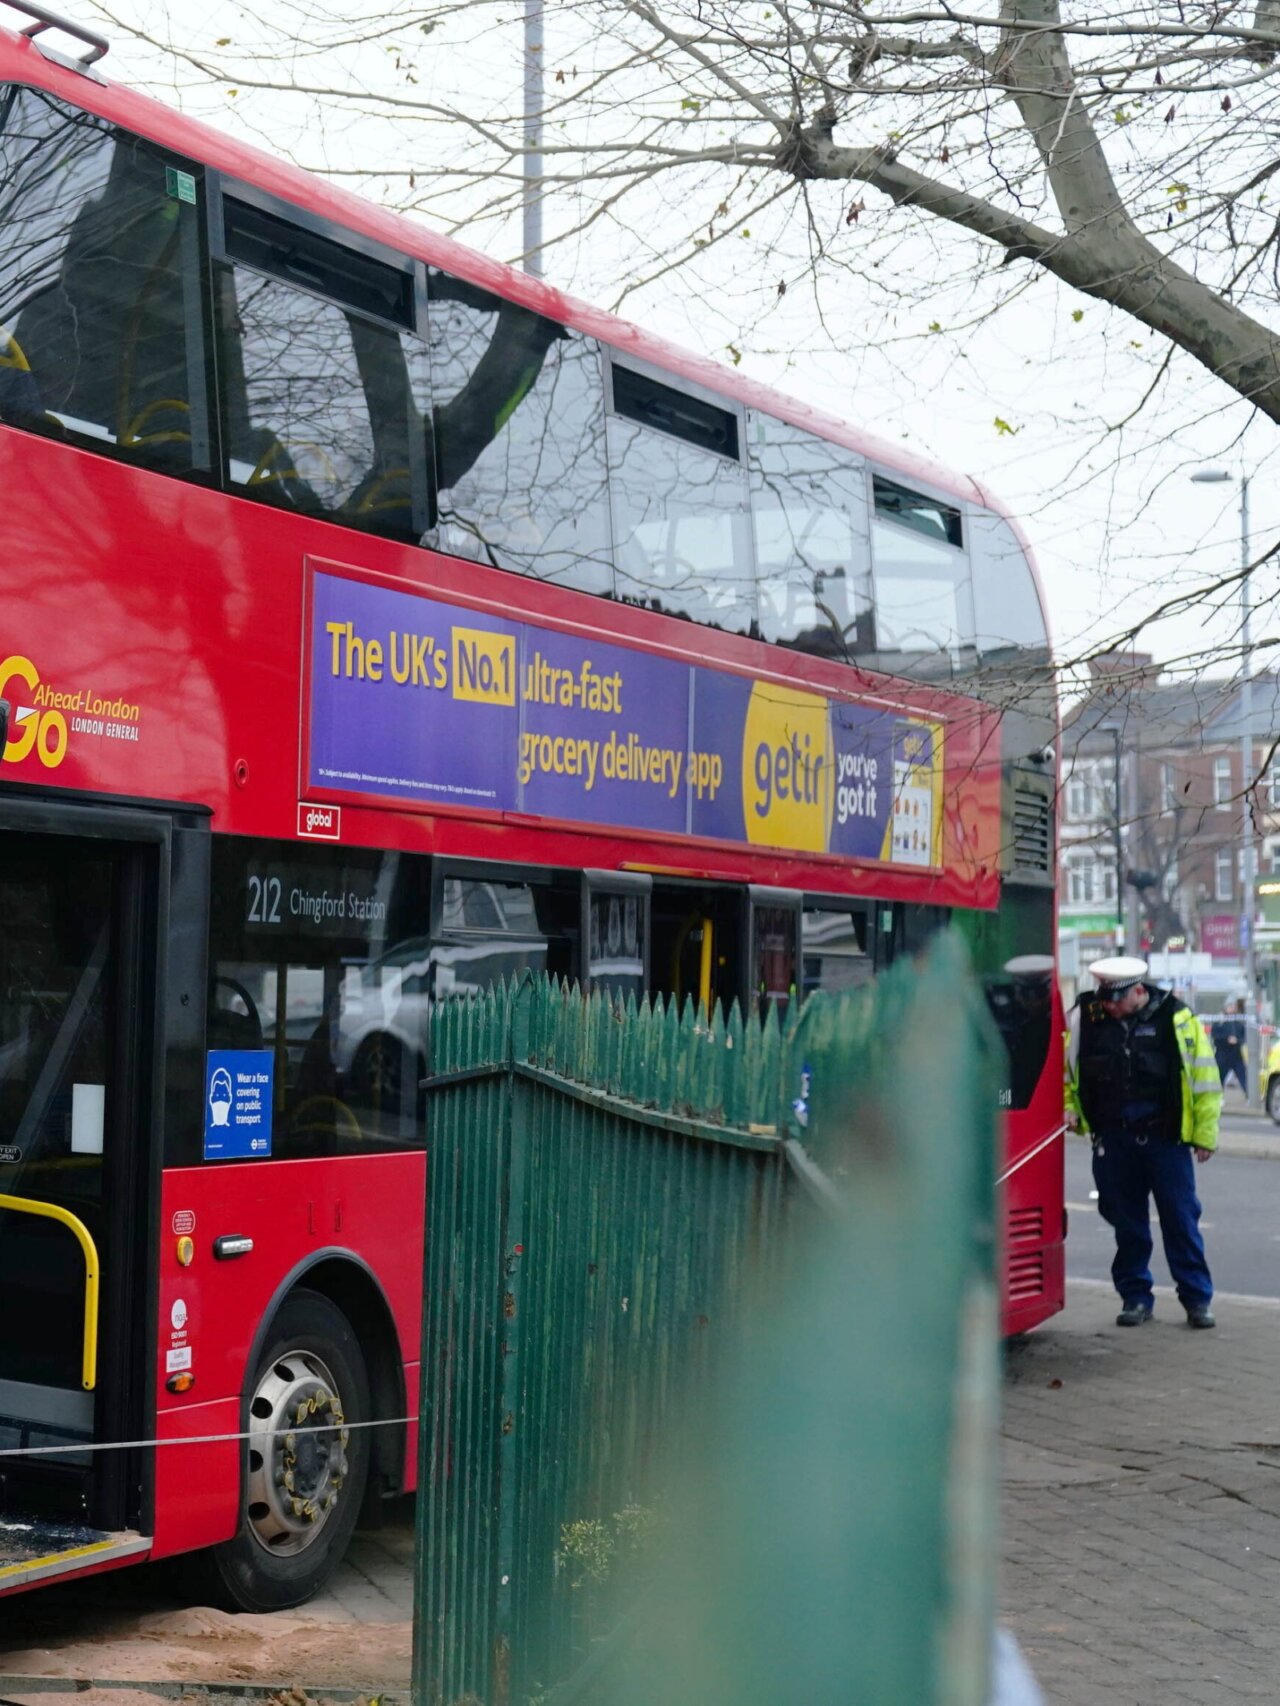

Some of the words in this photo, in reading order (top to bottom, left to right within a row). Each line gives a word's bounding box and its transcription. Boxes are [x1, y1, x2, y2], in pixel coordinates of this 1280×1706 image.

[326, 622, 383, 682] The
[389, 631, 448, 689] UK's
[458, 639, 510, 695] No.1
[523, 652, 623, 714] ultra-fast
[33, 684, 140, 721] Ahead-London
[71, 717, 104, 736] LONDON
[106, 723, 140, 741] GENERAL
[517, 731, 600, 791] grocery
[602, 730, 683, 799] delivery
[685, 752, 723, 800] app
[754, 731, 824, 819] getir
[837, 753, 878, 783] you've
[837, 785, 864, 824] got
[865, 780, 878, 819] it
[306, 809, 332, 832] global
[248, 875, 282, 923] 212
[290, 888, 345, 924] Chingford
[348, 892, 386, 921] Station
[236, 1087, 260, 1099] covering
[237, 1073, 252, 1083] Wear
[257, 1073, 269, 1083] face
[236, 1115, 261, 1126] transport
[245, 1100, 262, 1113] public
